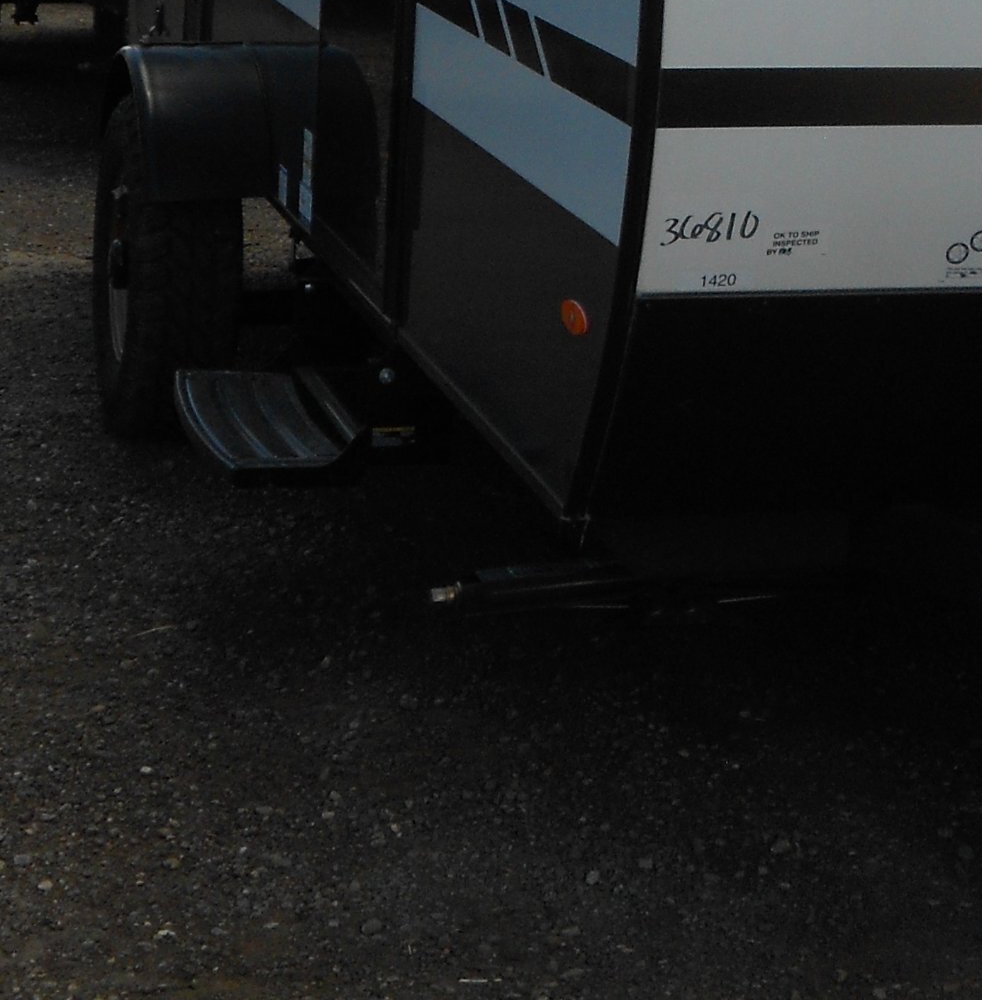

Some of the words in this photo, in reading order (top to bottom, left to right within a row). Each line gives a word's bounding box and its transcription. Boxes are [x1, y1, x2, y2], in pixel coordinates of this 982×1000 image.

[659, 210, 760, 247] 36810
[801, 230, 820, 238] SHIP
[772, 238, 818, 247] INSPECTED
[766, 248, 778, 256] BY
[700, 273, 737, 288] 1420
